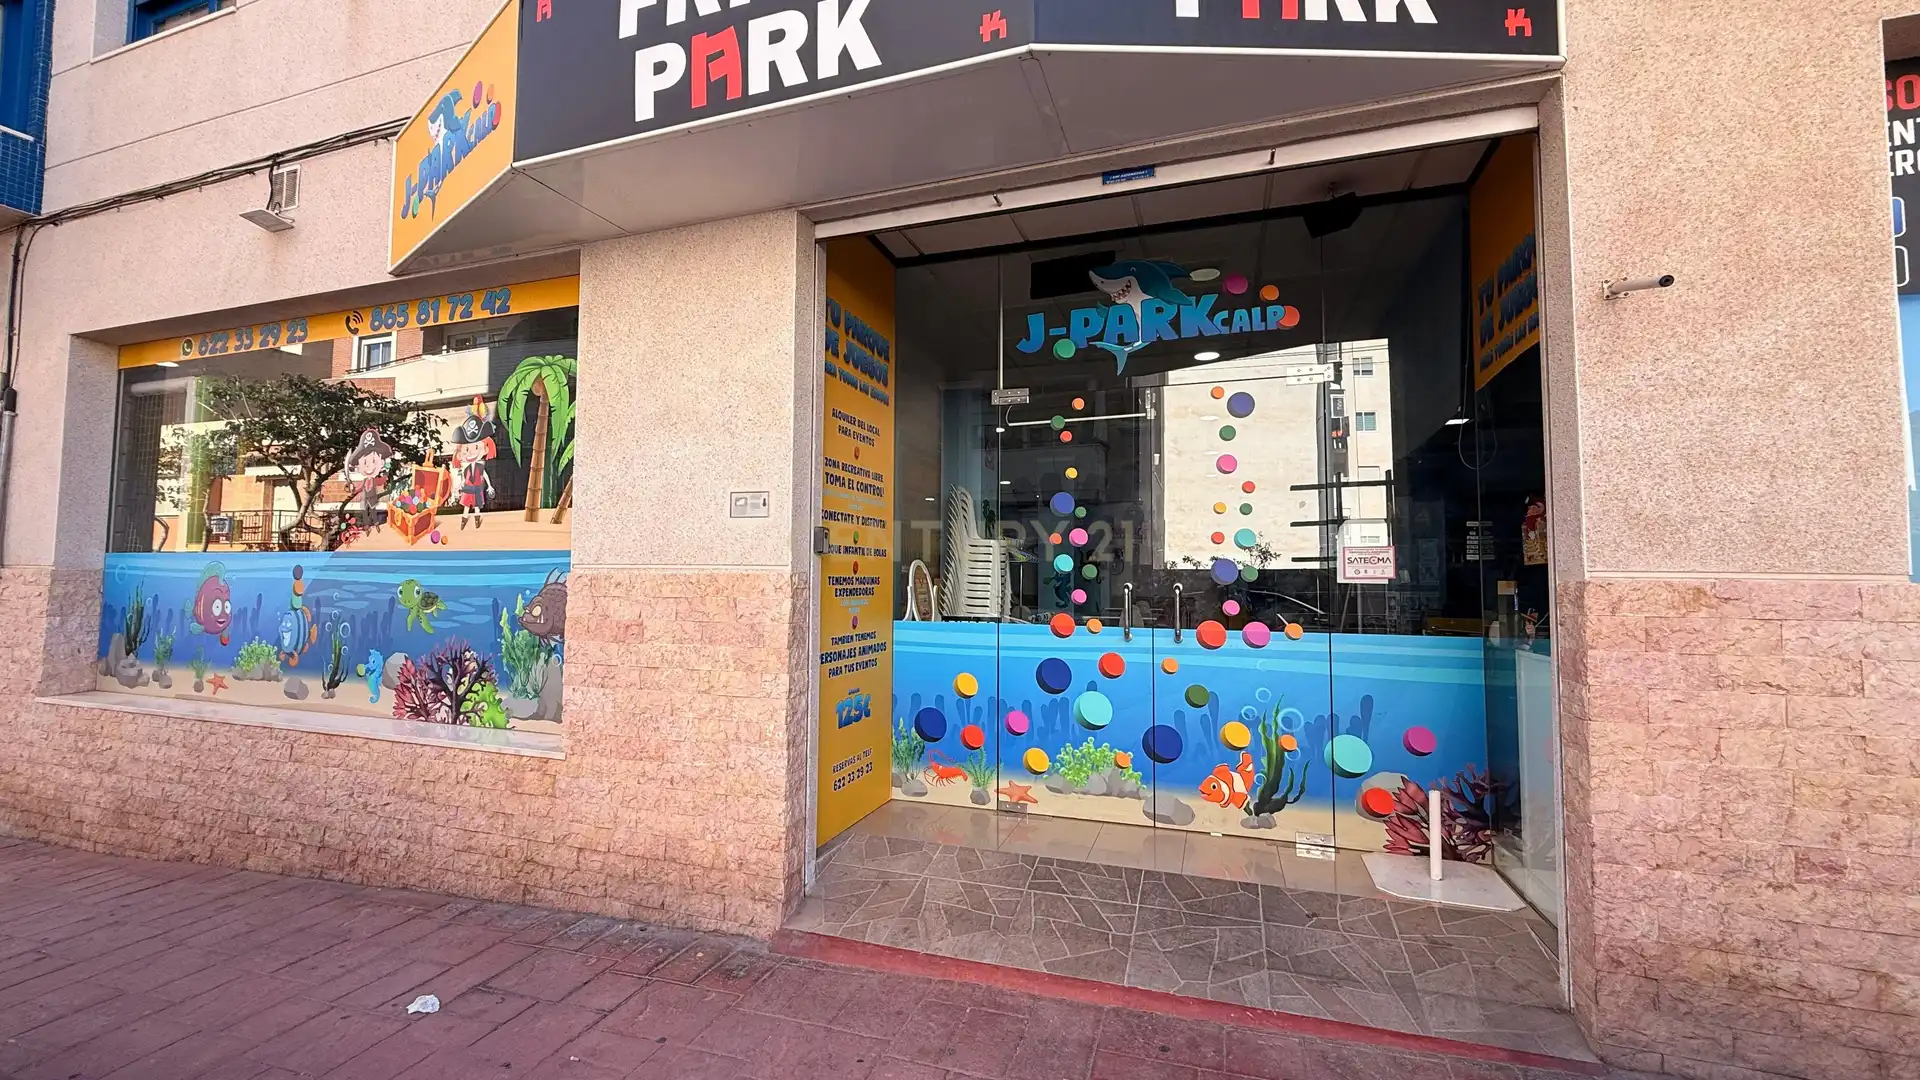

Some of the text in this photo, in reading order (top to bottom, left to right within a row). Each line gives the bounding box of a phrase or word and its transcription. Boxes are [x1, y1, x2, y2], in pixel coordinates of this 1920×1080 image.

[635, 0, 882, 122] PARK
[370, 288, 511, 331] 865 81 72 42
[1016, 294, 1285, 353] J-PARK CALP
[198, 318, 308, 356] 622 33 29 23
[832, 408, 880, 437] ALQUILER DEL LOCAL
[838, 424, 875, 447] PARA EVENTOS
[824, 456, 883, 482] ZONA RECREATIVA LIBRE
[825, 472, 846, 488] TOMA
[847, 478, 854, 490] EL
[856, 515, 860, 525] Y
[843, 545, 865, 556] INFANTIL
[866, 547, 872, 556] DE
[874, 548, 887, 558] BOLAS
[1347, 556, 1392, 565] SATECMA
[828, 576, 880, 586] TENEMOS MAQUINAS
[834, 587, 874, 597] EXPENDEDORAS
[831, 631, 876, 646] TAMBIEN TENEMOS
[820, 641, 887, 664] ERSONAJES ANIMADOS
[828, 658, 877, 678] PARA TUS EVENTOS
[833, 756, 856, 774] RESERVAS
[857, 753, 861, 761] AL
[833, 776, 845, 791] 622
[848, 771, 855, 784] 33
[866, 762, 872, 774] 23
